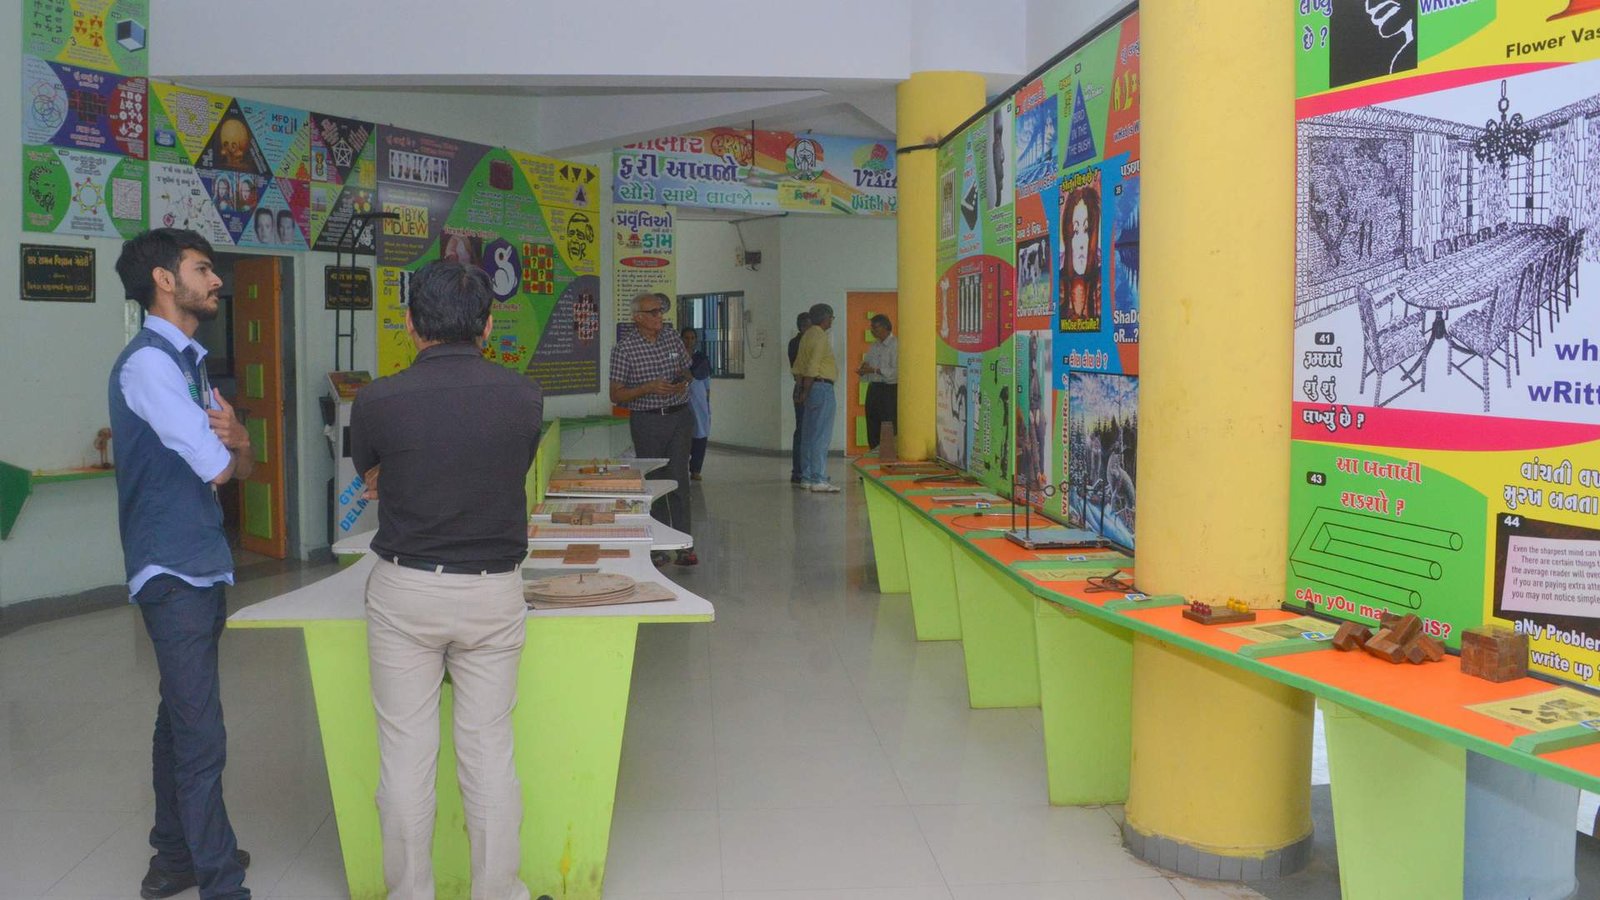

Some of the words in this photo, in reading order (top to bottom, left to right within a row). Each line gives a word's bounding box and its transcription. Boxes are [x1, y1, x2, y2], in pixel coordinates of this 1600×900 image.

[1320, 26, 1328, 47] ?
[1506, 35, 1566, 58] Flower
[620, 154, 658, 180] ફરી
[666, 155, 739, 182] આવજો
[620, 183, 655, 201] સૌને
[662, 187, 698, 204] સાથે
[616, 211, 672, 232] પ્રવૃત્તિઓ
[642, 233, 672, 248] કામ
[1114, 309, 1140, 324] ShaD
[1320, 334, 1331, 344] 41
[1554, 338, 1598, 361] wh
[1303, 375, 1318, 402] શું
[1320, 376, 1336, 403] શું
[1302, 404, 1337, 433] લખ્યું
[1339, 405, 1352, 428] છે
[1356, 412, 1366, 429] ?
[1310, 474, 1322, 484] 43
[1336, 457, 1359, 475] આ
[1363, 460, 1422, 484] બનાવી
[1520, 456, 1572, 485] વાંચતી
[1340, 488, 1388, 514] શકશો
[1395, 498, 1406, 516] ?
[1503, 484, 1542, 510] મુરખ
[1548, 490, 1598, 516] બનતા
[1504, 515, 1520, 528] 44
[1513, 544, 1528, 553] Even
[1529, 545, 1539, 554] the
[1540, 547, 1567, 556] sharpest
[1522, 555, 1539, 564] There
[1552, 558, 1574, 566] certain
[1575, 560, 1596, 569] things
[1523, 568, 1549, 577] average
[1550, 569, 1570, 577] reader
[1512, 591, 1524, 599] you
[1526, 592, 1540, 602] may
[1542, 592, 1552, 601] not
[1554, 593, 1575, 602] notice
[1545, 581, 1567, 591] paying
[1296, 588, 1322, 604] cAn
[1326, 594, 1355, 612] yOu
[1360, 604, 1391, 620] ma
[1424, 619, 1452, 638] iS?
[1514, 618, 1542, 640] aNy
[1530, 650, 1570, 672] write
[1574, 660, 1593, 682] up
